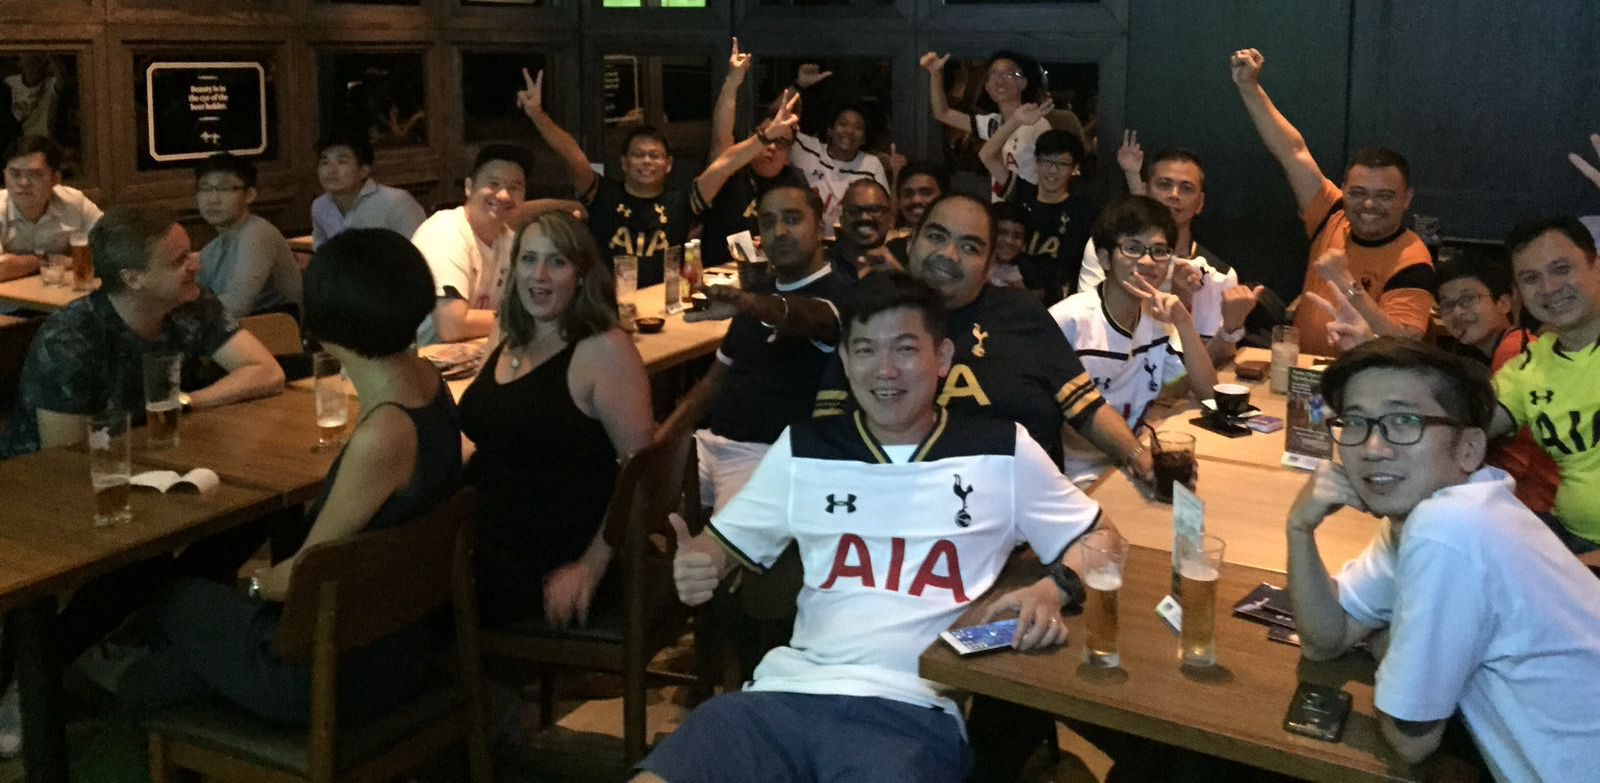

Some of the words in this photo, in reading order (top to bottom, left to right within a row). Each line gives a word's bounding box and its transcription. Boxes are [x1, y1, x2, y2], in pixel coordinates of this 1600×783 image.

[609, 226, 669, 257] AIA
[1027, 230, 1060, 259] IA
[818, 533, 971, 604] AIA
